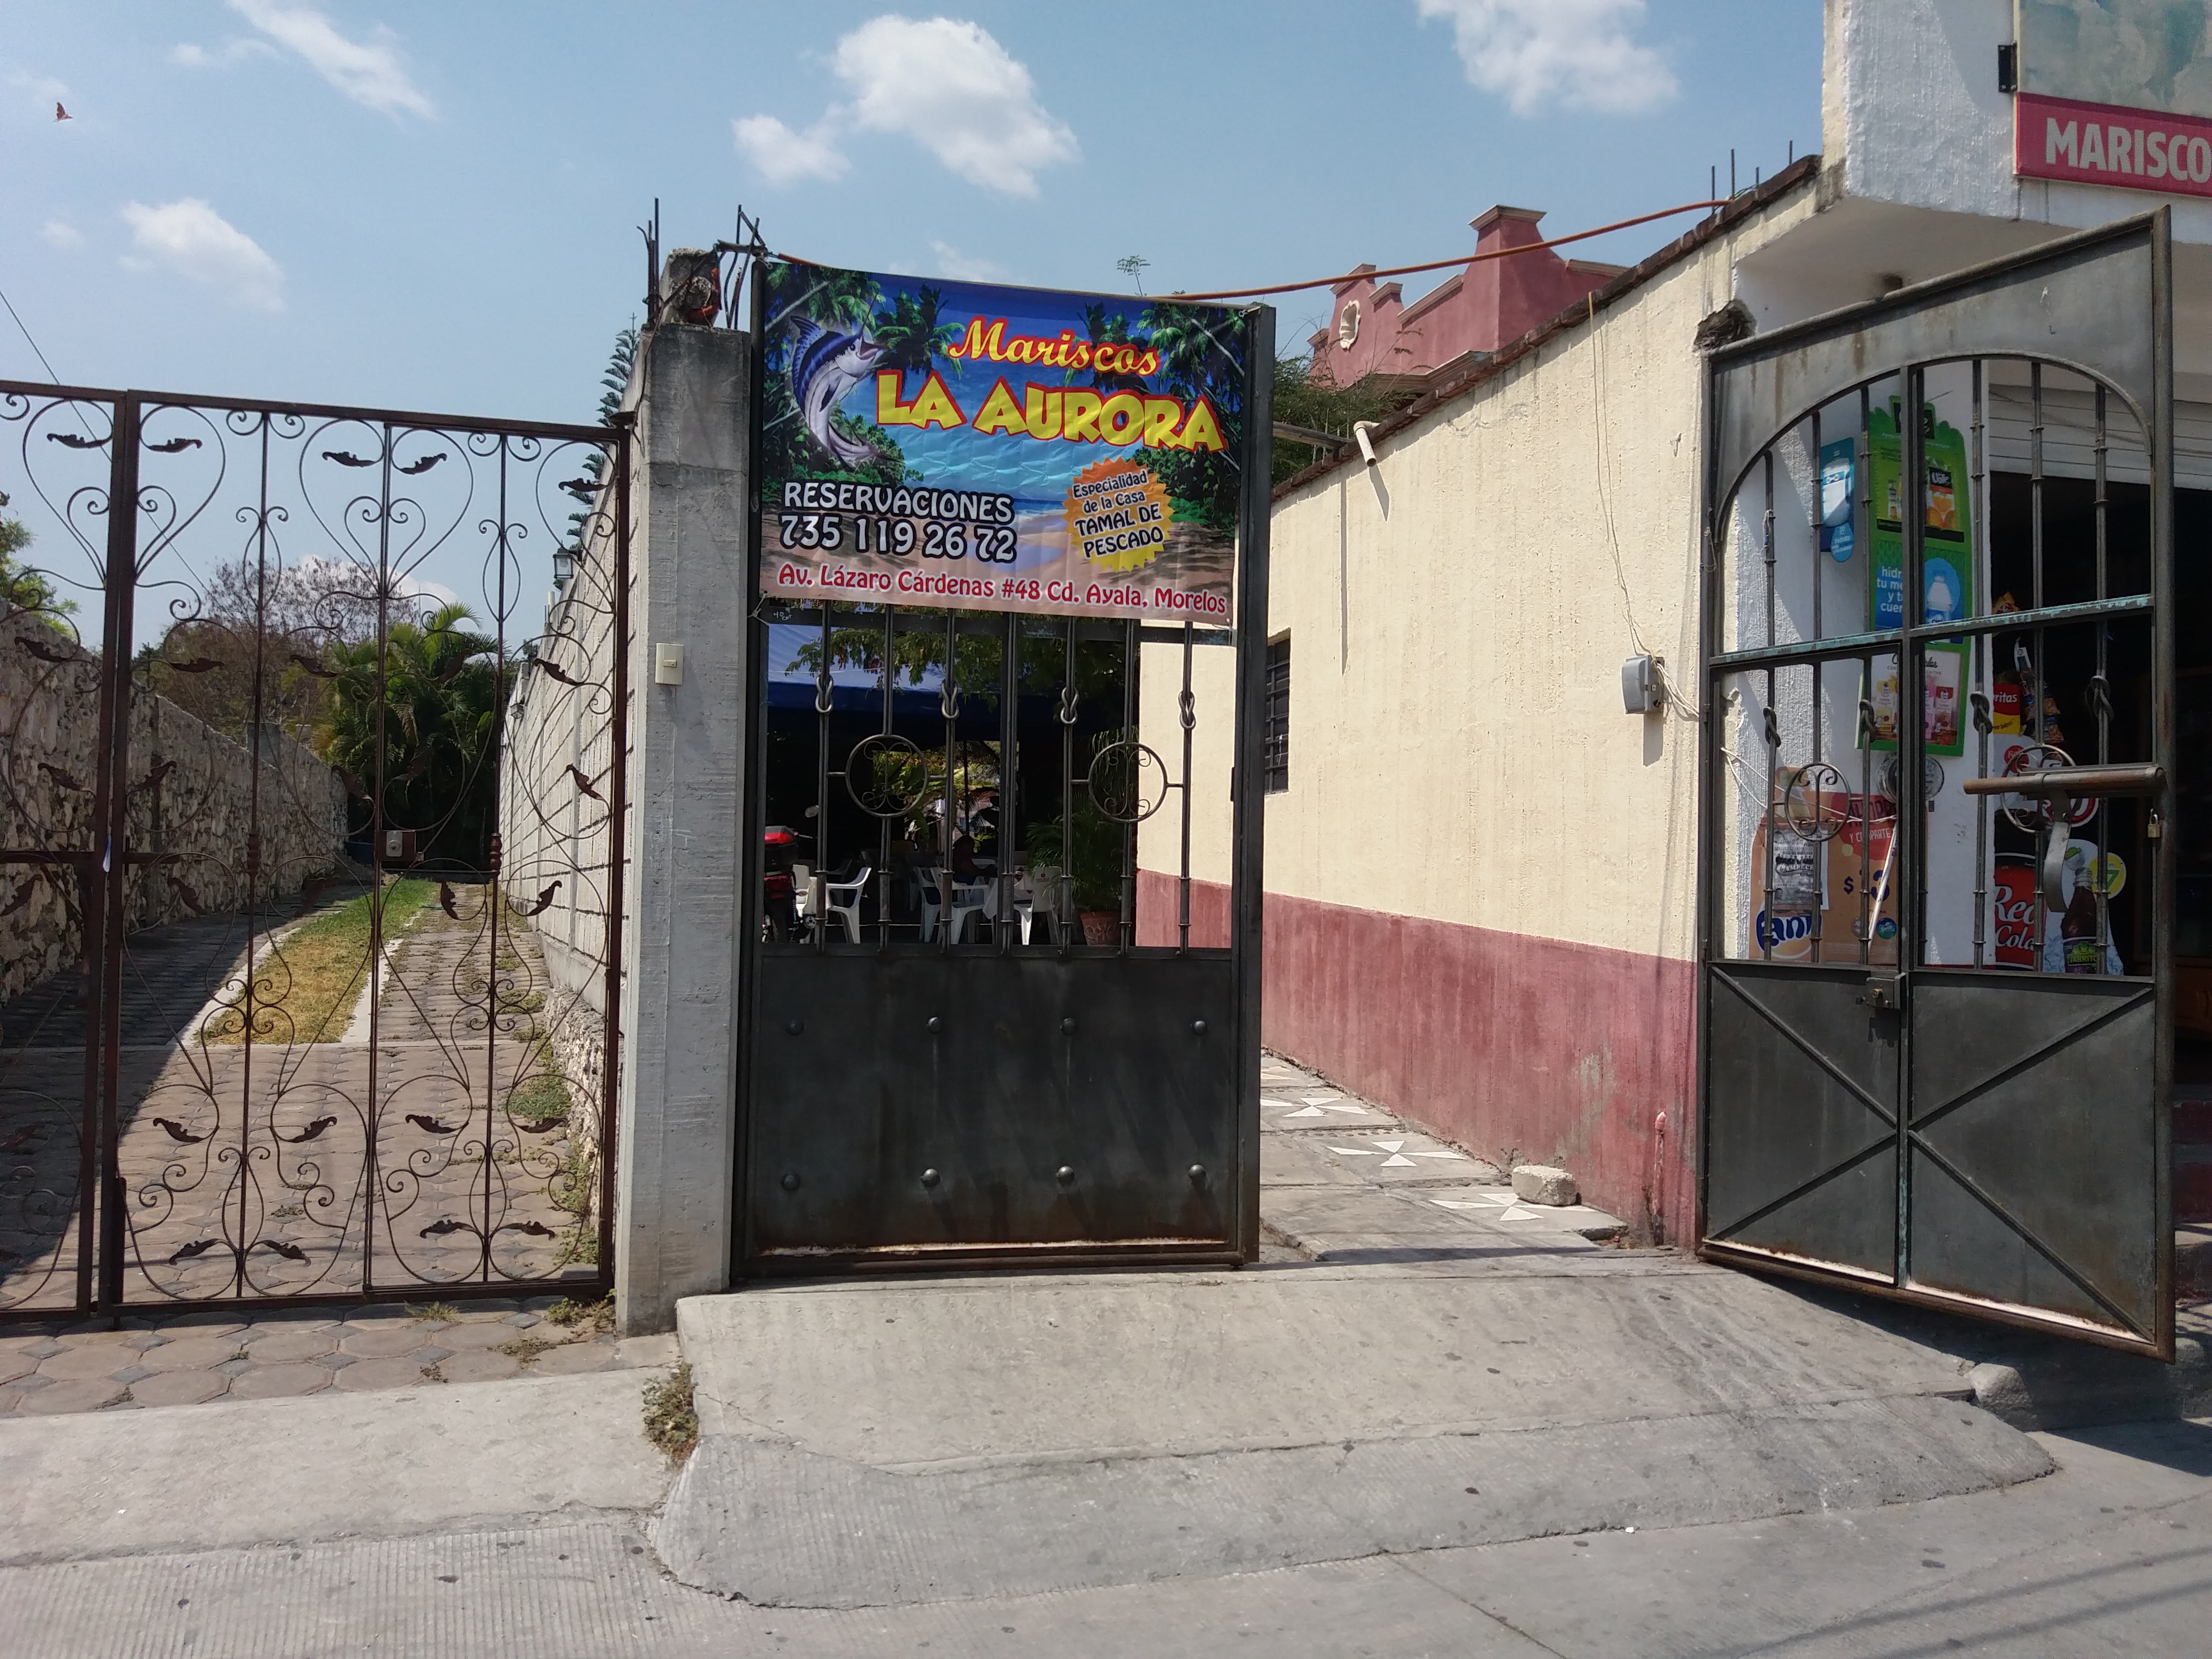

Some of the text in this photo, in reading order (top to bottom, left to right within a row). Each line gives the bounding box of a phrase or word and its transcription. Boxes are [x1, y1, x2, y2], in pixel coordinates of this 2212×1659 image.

[2045, 117, 2211, 183] MARISCO
[948, 317, 1160, 376] Mariscos
[877, 370, 1227, 453] LA AURORA
[1073, 470, 1148, 498] Especialidad
[784, 481, 1013, 524] RESERVACIONES
[1083, 491, 1146, 513] de la Casa
[1075, 503, 1162, 536] TAMAL DE
[780, 514, 1015, 562] 735 119 26 72
[1083, 526, 1164, 558] PESCADO
[779, 563, 1227, 614] Av. Lázaro Cárdenas #48 Cd. Ayala, Morelos
[1880, 603, 1903, 614] cuer
[1993, 691, 2017, 703] ritas
[1856, 827, 1891, 842] COPARTE
[1776, 863, 1814, 872] CAMPECH
[1756, 910, 1822, 951] Fan
[2068, 954, 2097, 963] JARRITO
